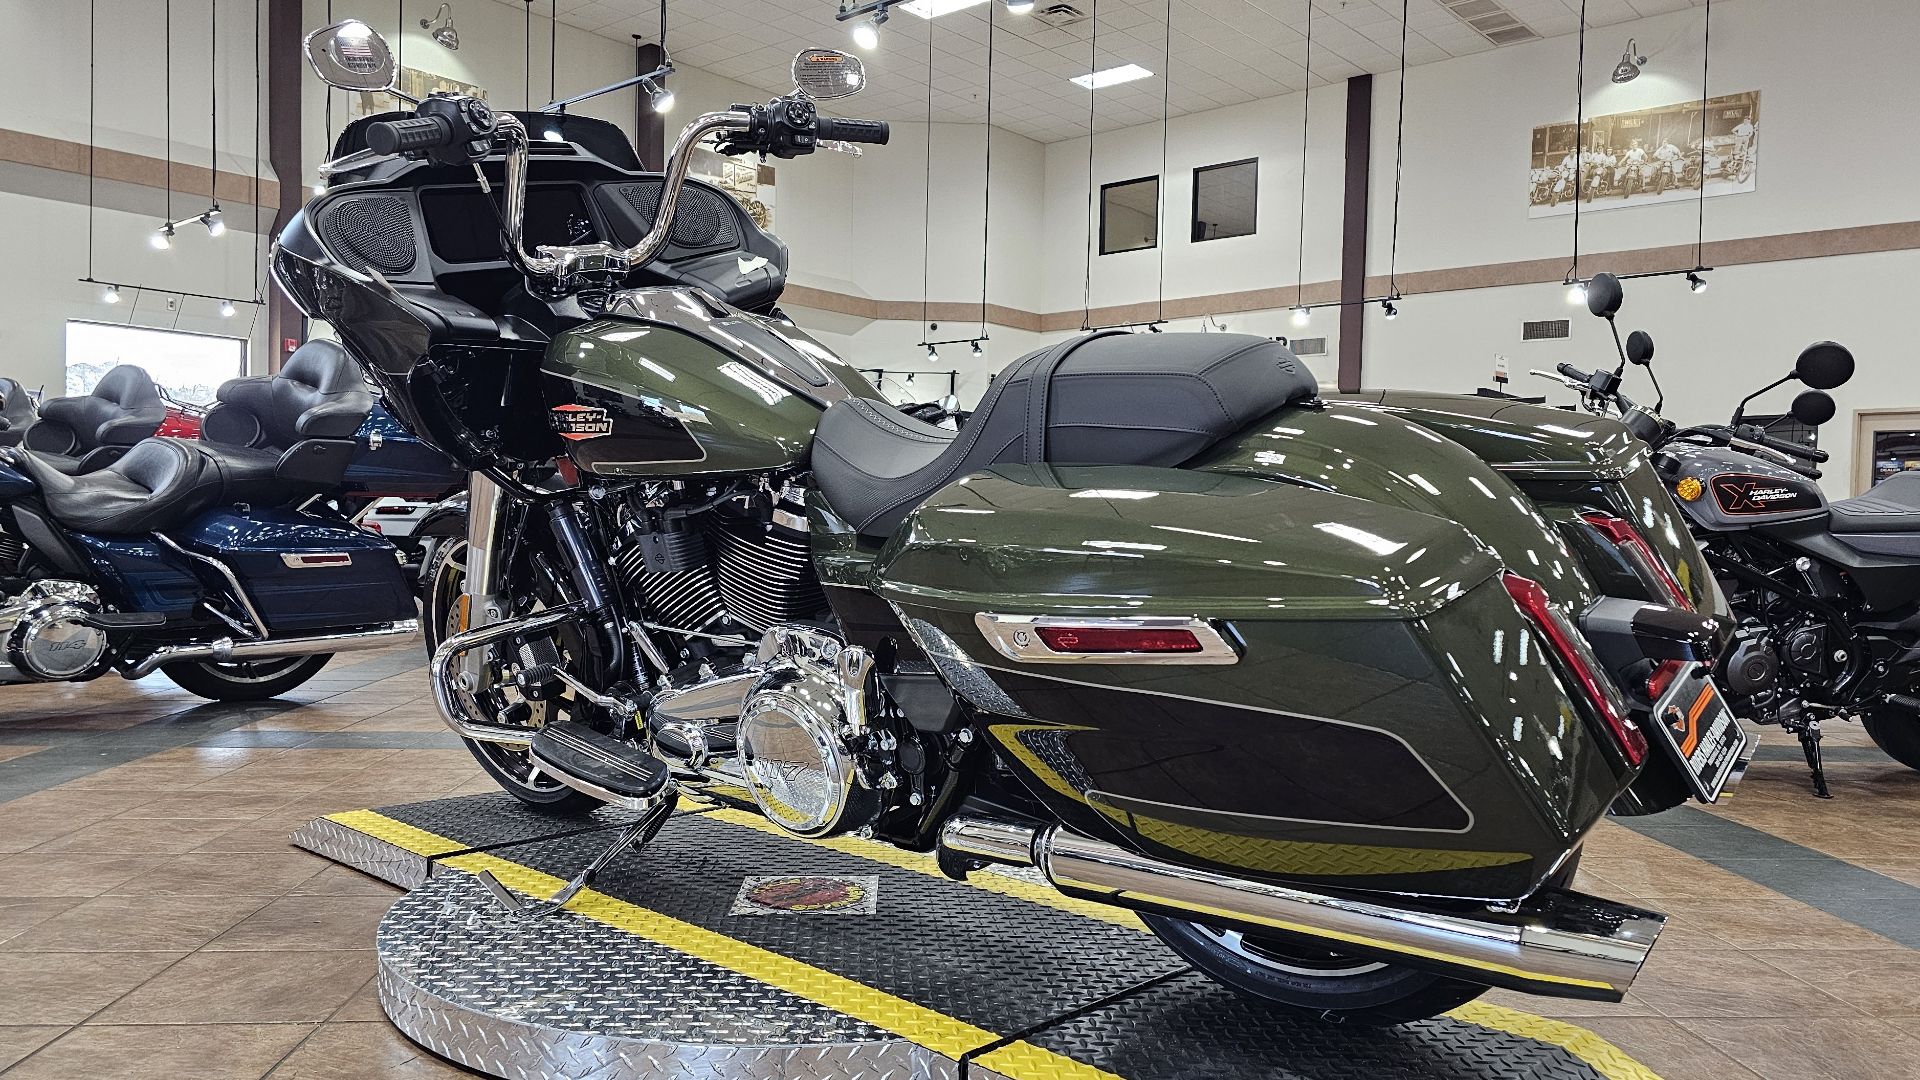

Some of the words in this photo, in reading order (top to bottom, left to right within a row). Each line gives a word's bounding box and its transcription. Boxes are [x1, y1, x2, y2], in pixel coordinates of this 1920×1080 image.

[1749, 487, 1788, 496] HARLEY-
[1752, 492, 1797, 501] DAVIDSON
[50, 639, 87, 652] 114
[758, 756, 810, 781] 117
